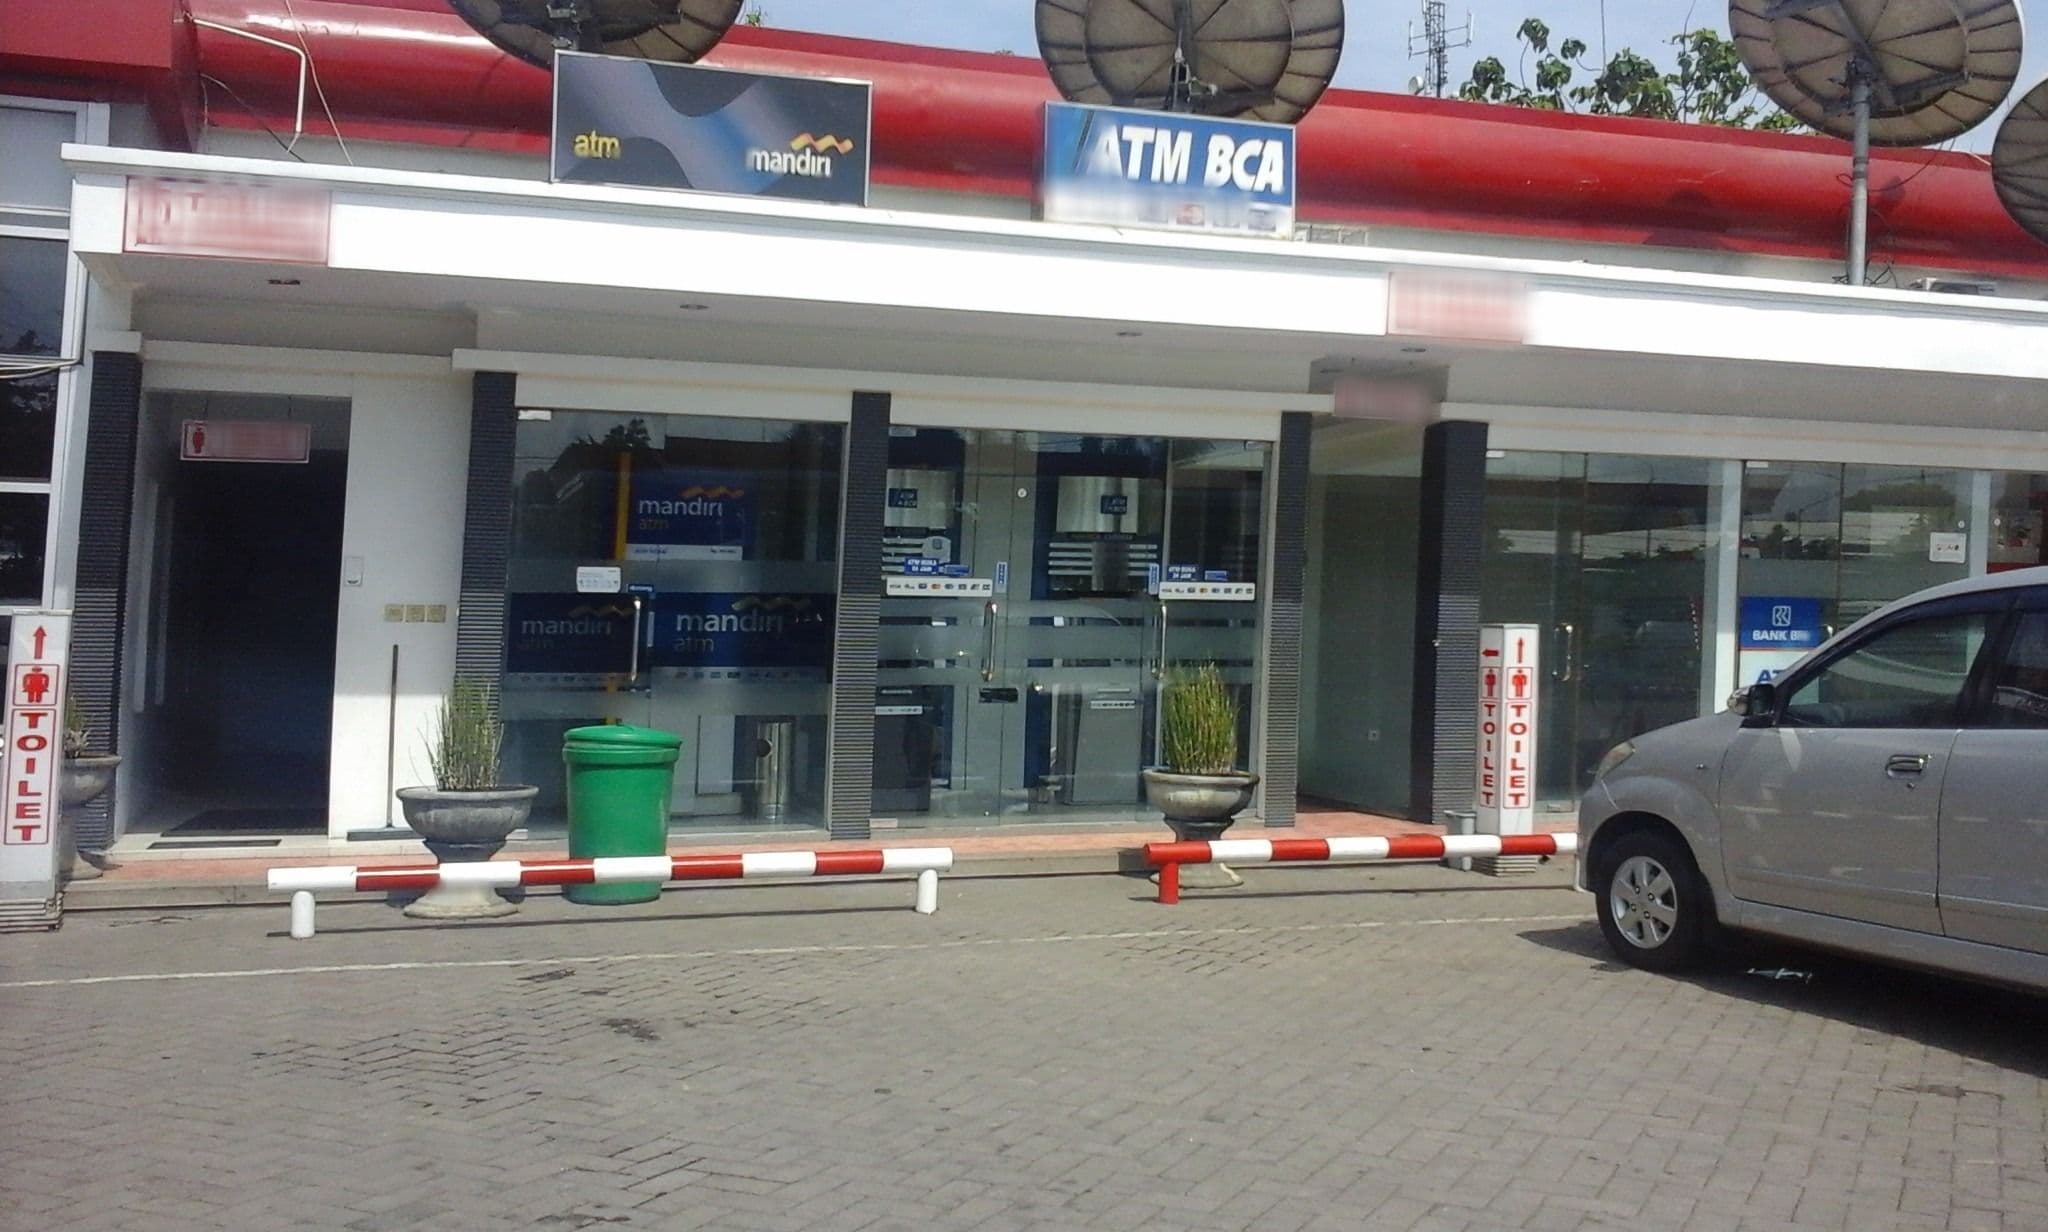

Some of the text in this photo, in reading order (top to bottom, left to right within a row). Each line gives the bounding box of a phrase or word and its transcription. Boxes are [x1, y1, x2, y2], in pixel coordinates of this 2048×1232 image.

[573, 130, 621, 159] atm
[1087, 124, 1284, 193] ATM BCA
[748, 147, 831, 177] mandiri
[638, 497, 723, 517] mandiri
[521, 615, 612, 636] mandiri
[676, 608, 783, 633] mandiri
[1752, 629, 1788, 641] BANK
[675, 636, 714, 652] atm
[1482, 703, 1496, 805] TOILET
[1508, 704, 1528, 806] TOILET
[13, 712, 49, 841] TOILET
